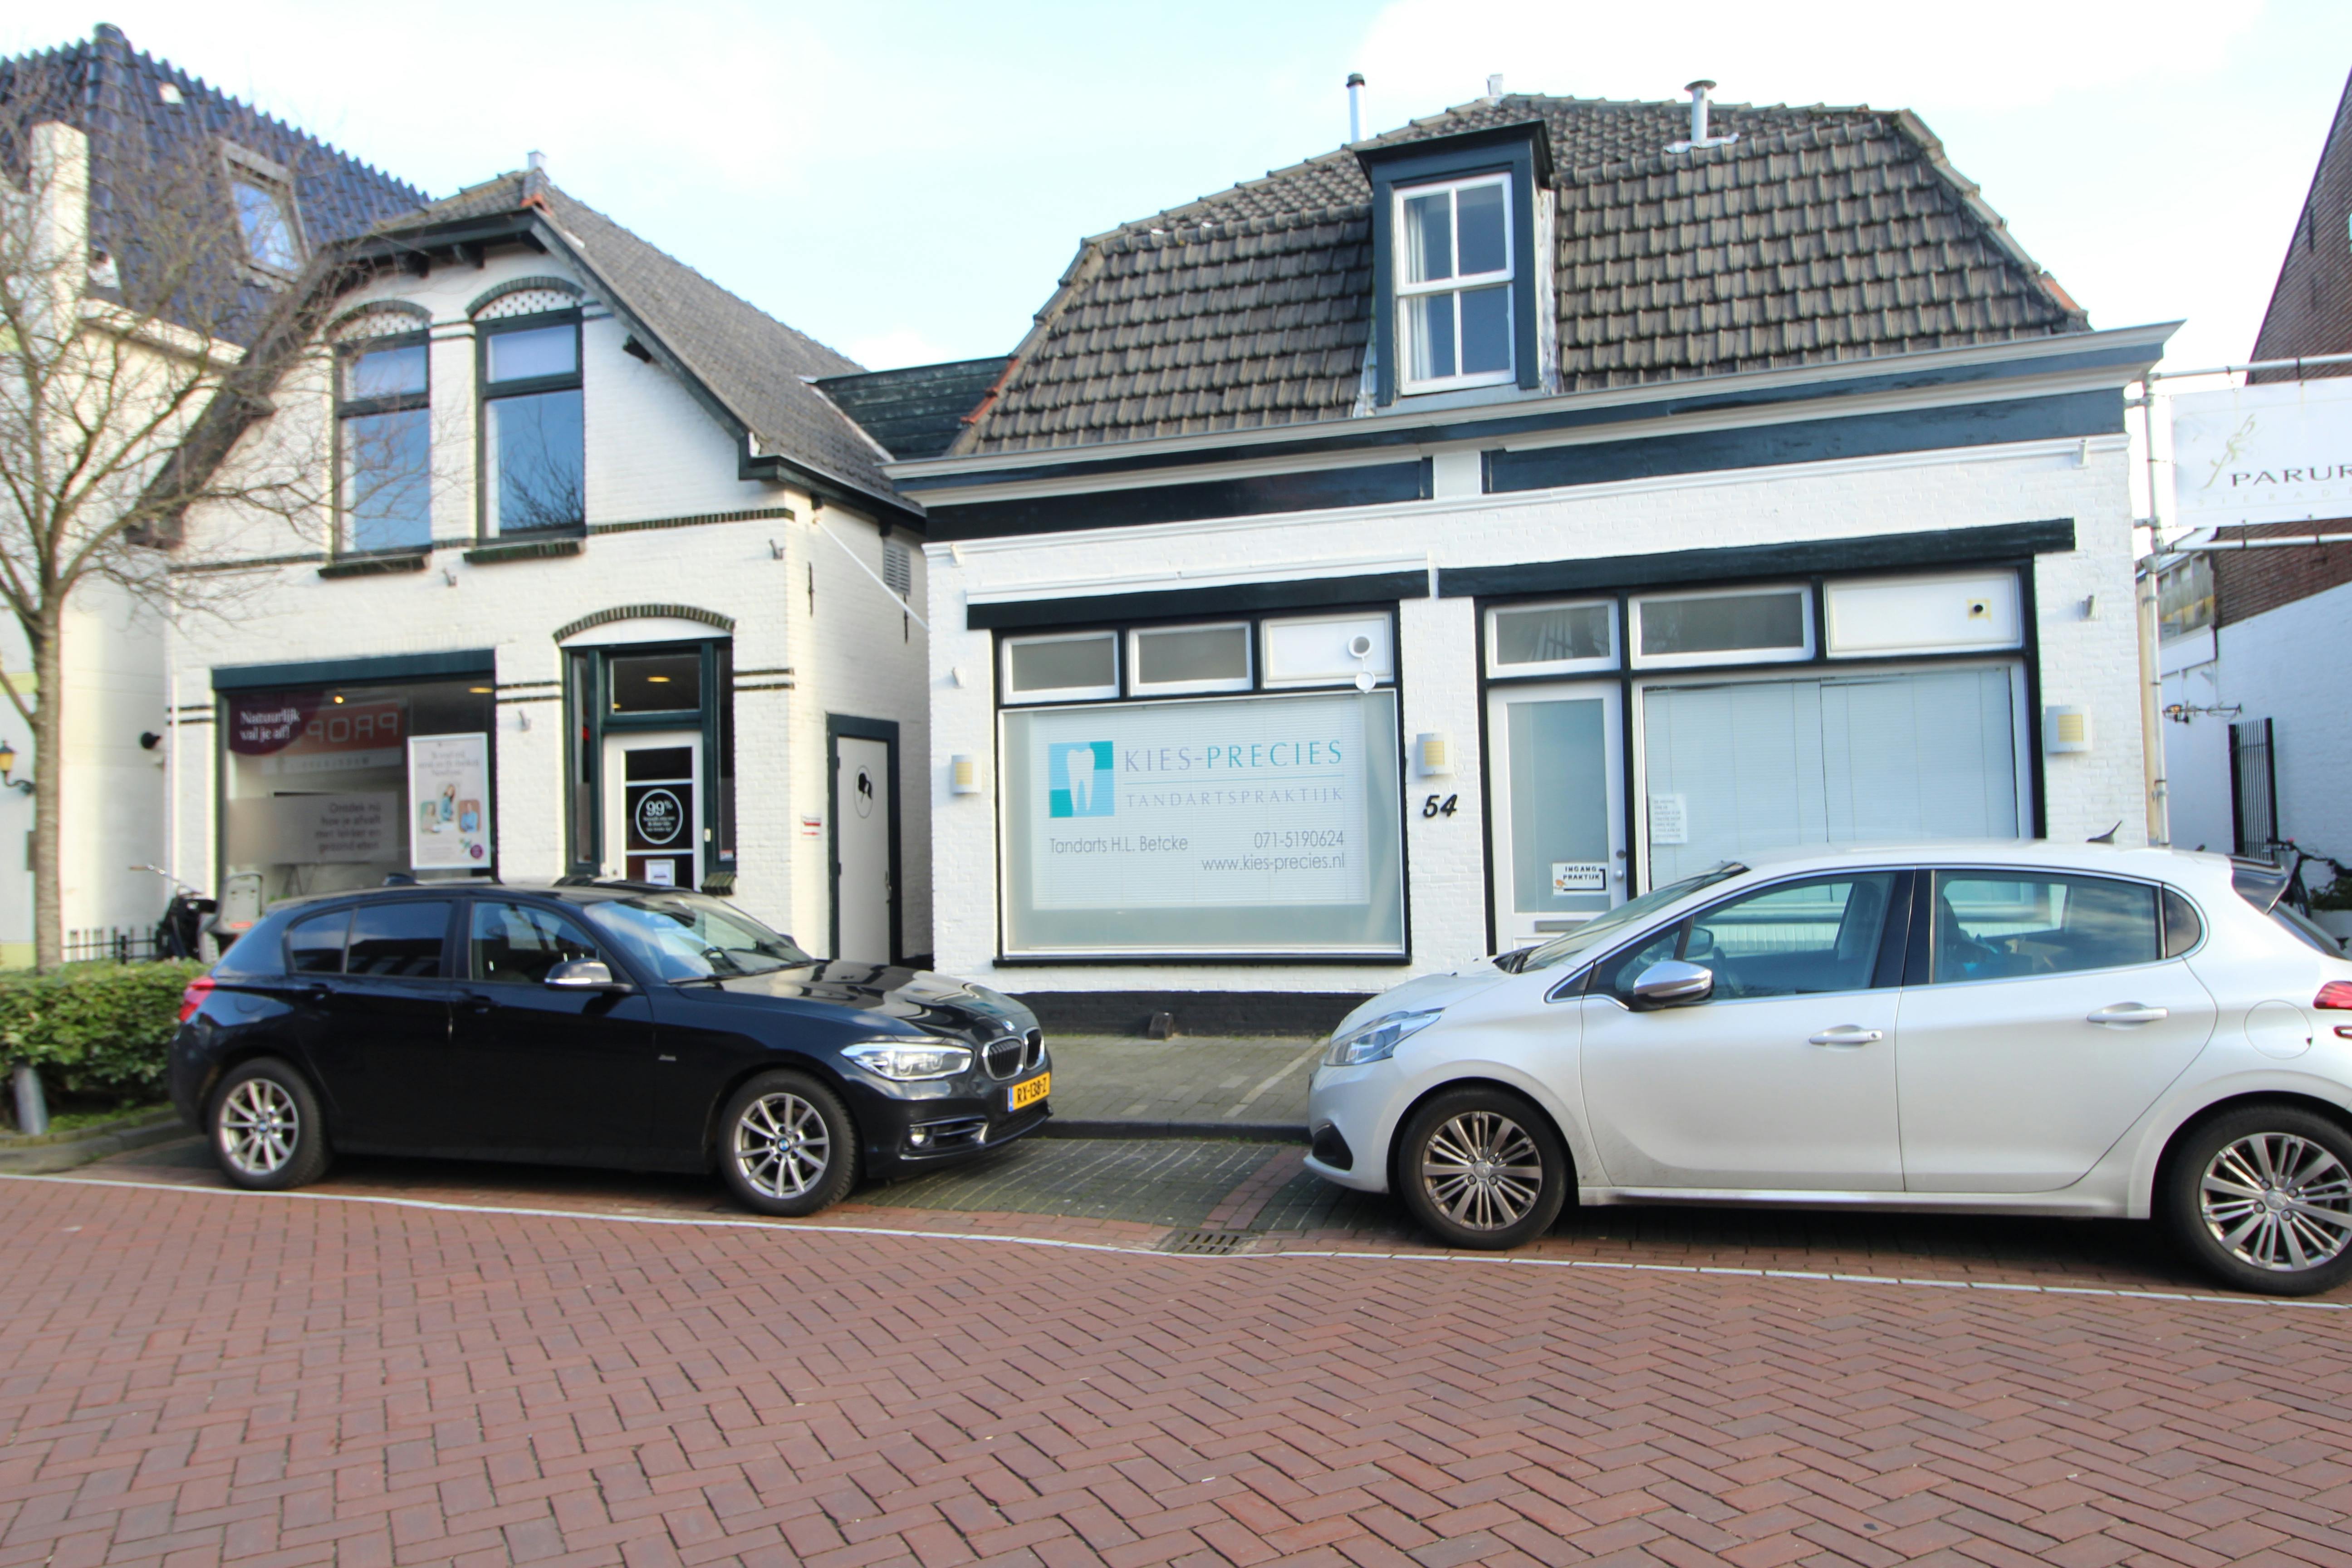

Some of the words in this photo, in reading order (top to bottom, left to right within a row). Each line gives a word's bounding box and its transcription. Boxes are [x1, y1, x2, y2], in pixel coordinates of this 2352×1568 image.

[240, 707, 300, 726] Natuurlijk
[240, 726, 258, 740] val
[259, 727, 272, 743] je
[272, 725, 290, 739] af!
[1125, 740, 1342, 772] KIES-PRECIES
[1127, 787, 1343, 808] TANDARTSPRAKTIJK
[1423, 794, 1457, 818] 54
[1050, 837, 1107, 853] Tandarts
[1111, 836, 1135, 852] H.L.
[1140, 835, 1188, 851] Betcke
[1254, 830, 1344, 848] 071-5190624
[1201, 852, 1345, 873] www.kies-precies.nl
